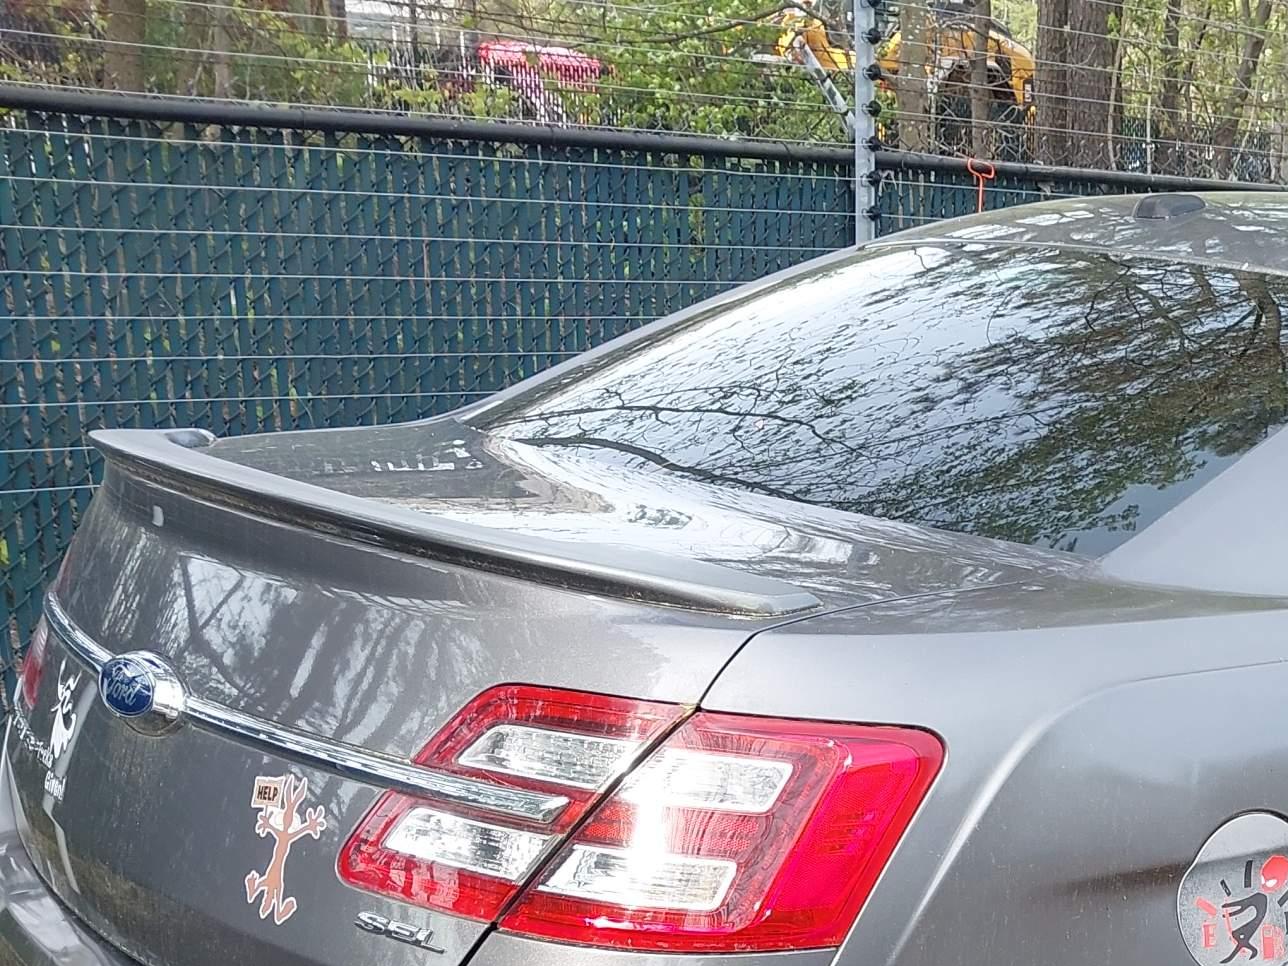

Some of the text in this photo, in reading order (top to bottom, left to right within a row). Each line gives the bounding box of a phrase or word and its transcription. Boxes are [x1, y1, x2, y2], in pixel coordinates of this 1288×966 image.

[103, 665, 142, 706] Ford
[256, 785, 278, 801] HELP
[353, 911, 447, 953] SEL
[1203, 924, 1216, 948] E
